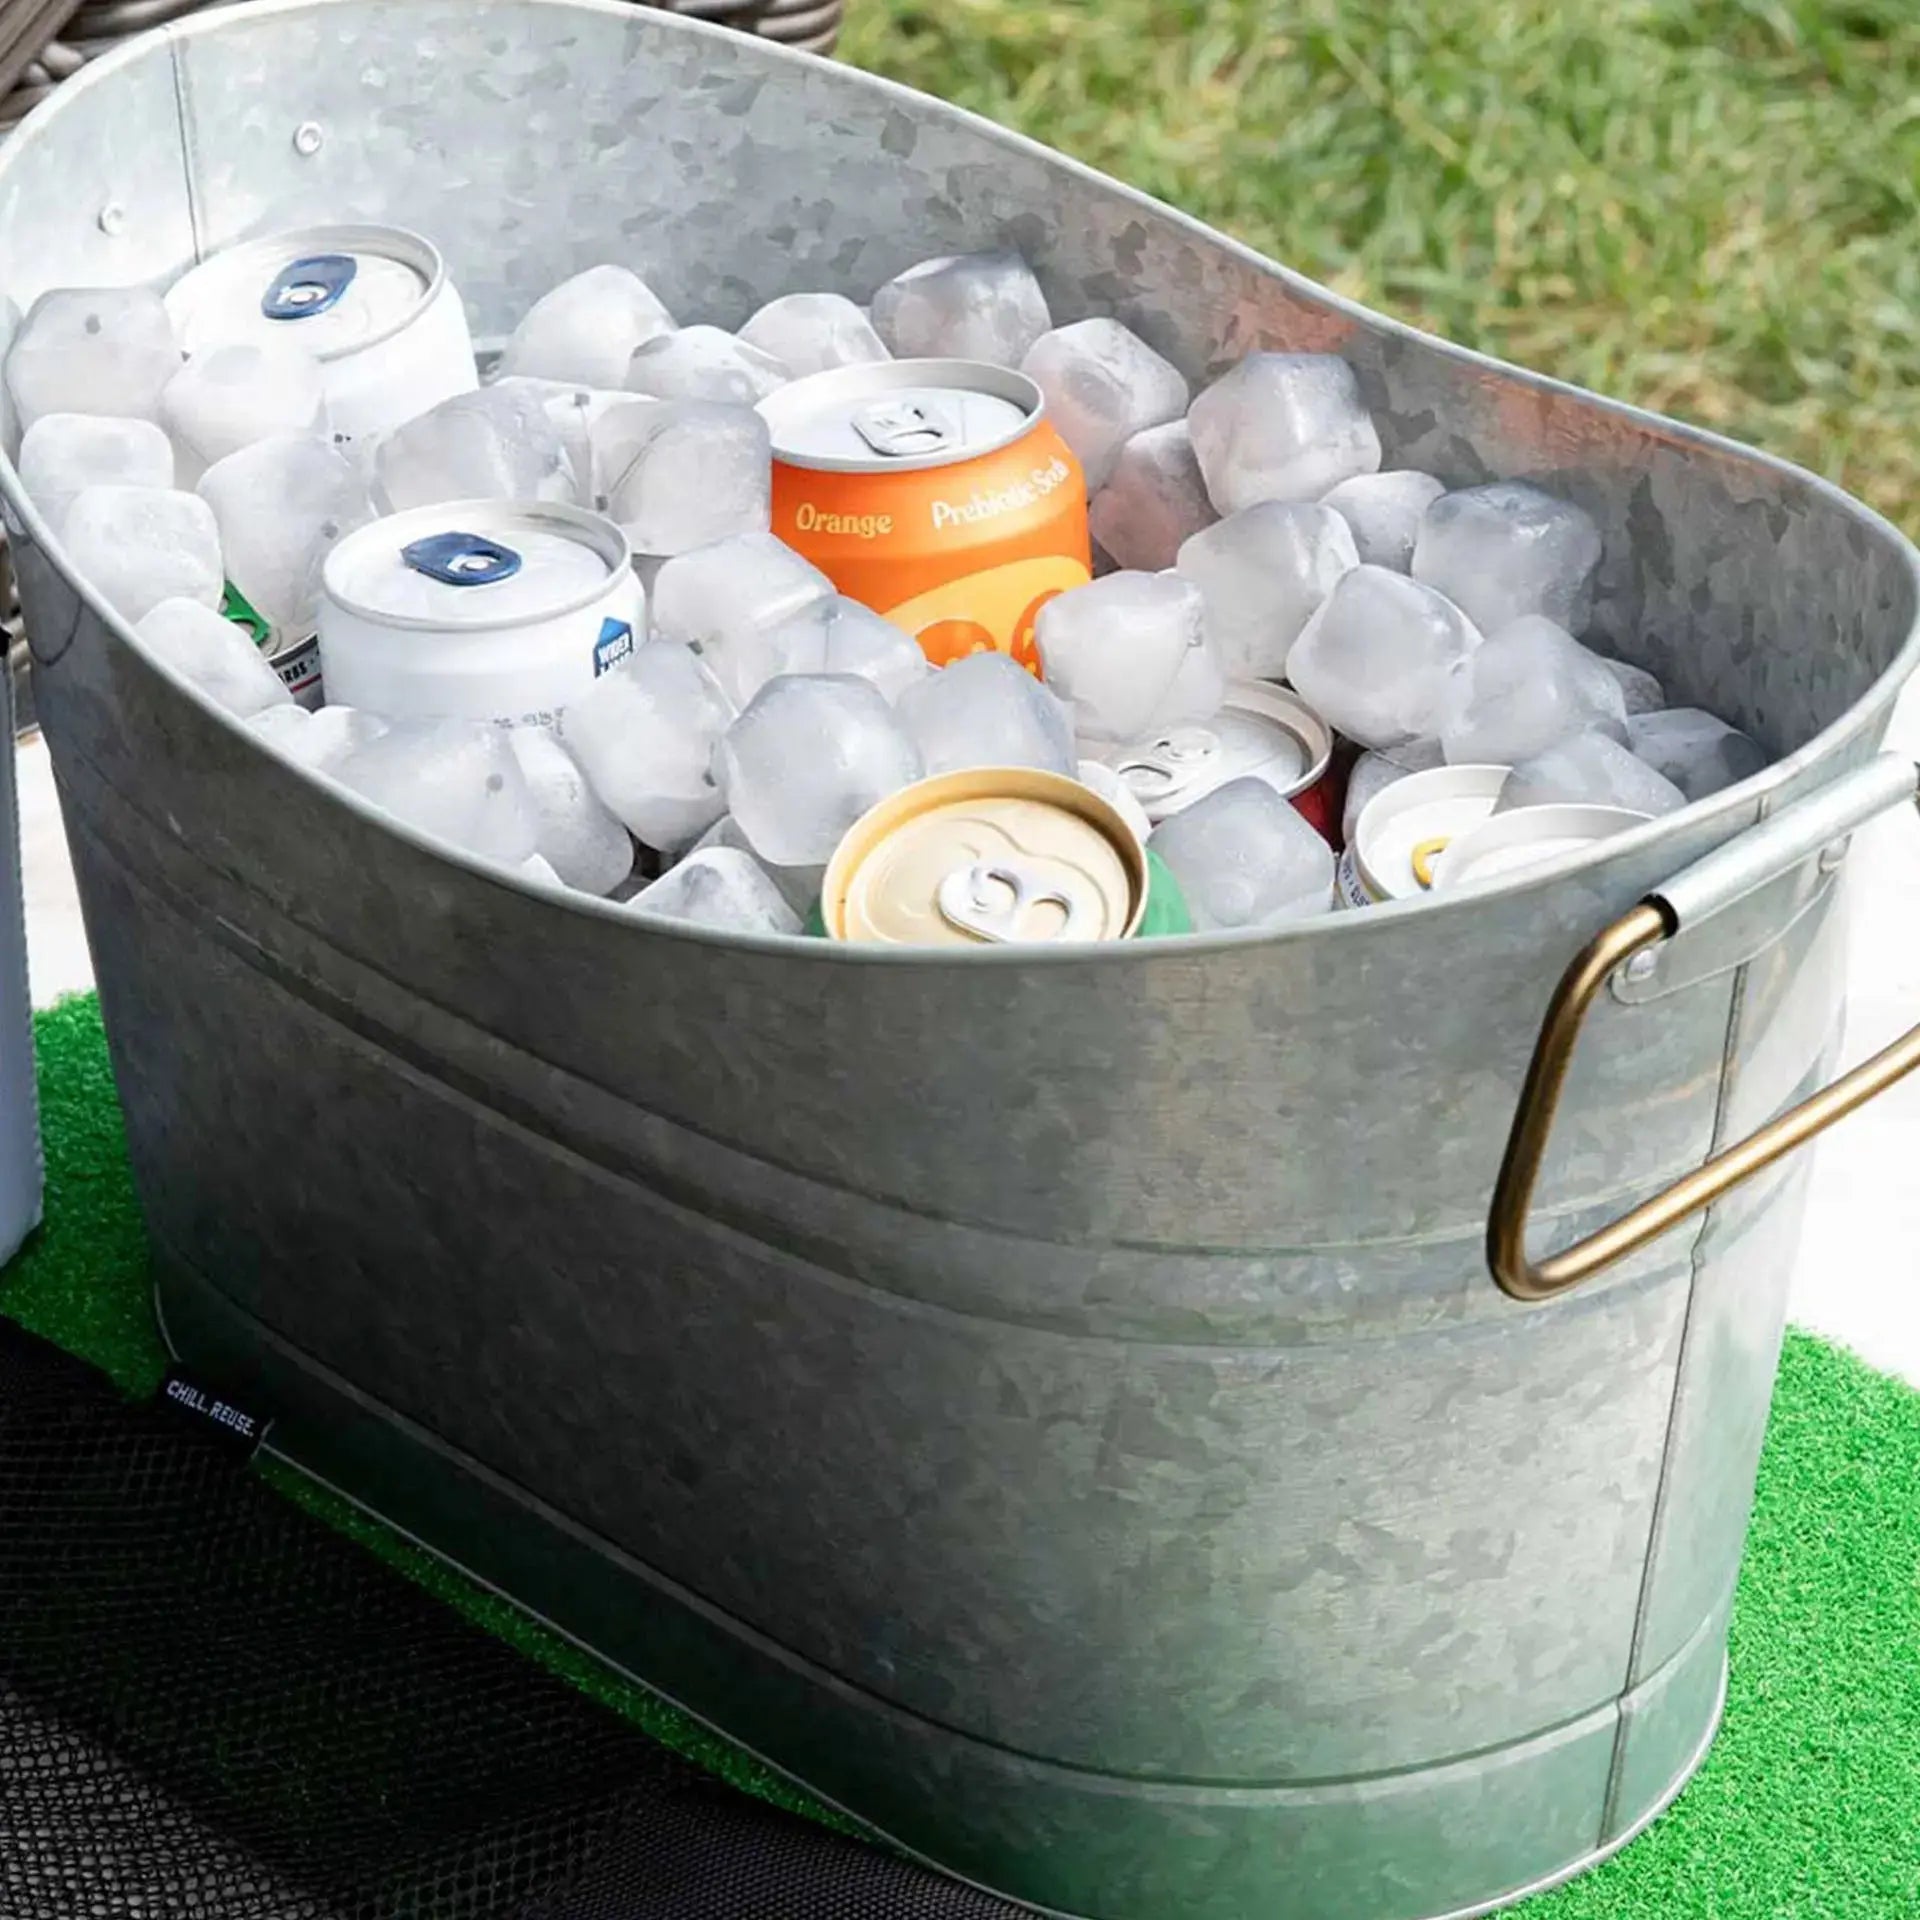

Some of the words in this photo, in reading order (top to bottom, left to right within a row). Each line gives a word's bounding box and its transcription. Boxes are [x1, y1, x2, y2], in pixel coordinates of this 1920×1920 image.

[796, 503, 893, 539] Orange
[166, 1380, 209, 1413] CHILL.
[208, 1401, 256, 1438] REUSE.
